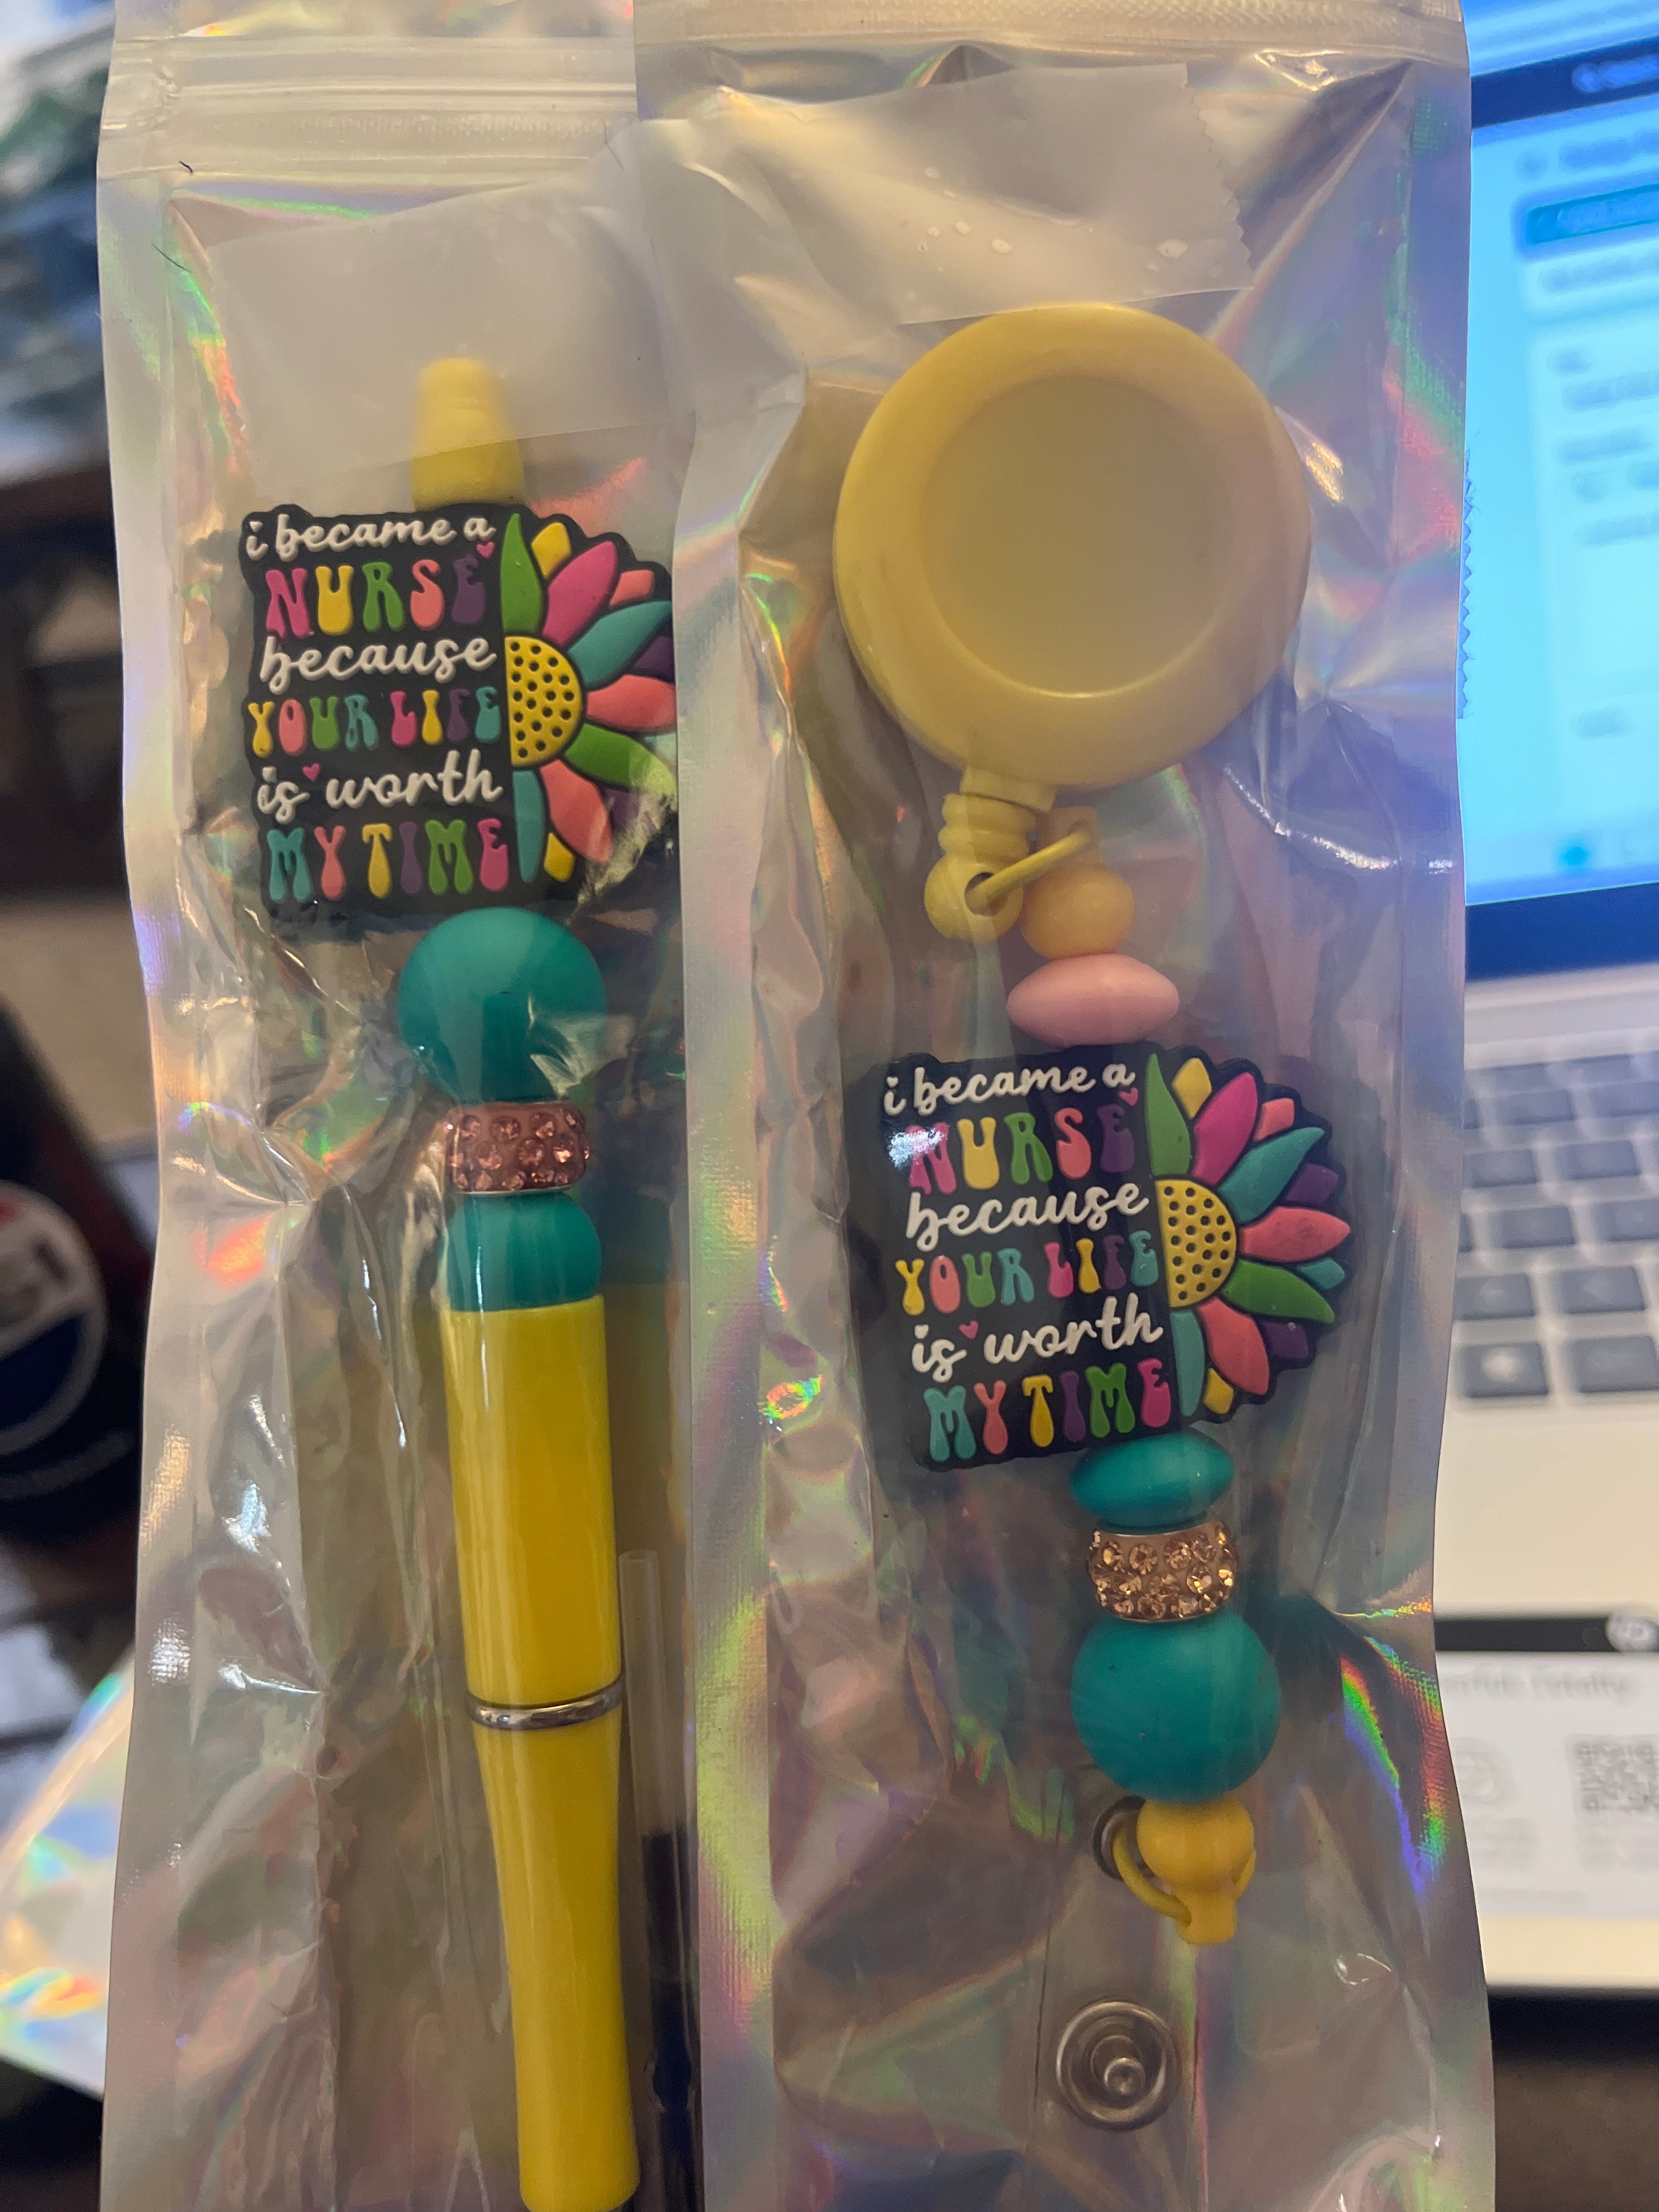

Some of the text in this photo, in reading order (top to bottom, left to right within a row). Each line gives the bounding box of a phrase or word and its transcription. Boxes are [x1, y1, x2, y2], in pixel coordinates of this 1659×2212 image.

[246, 514, 496, 562] i became a
[265, 555, 485, 639] NURSE
[259, 636, 497, 696] because
[248, 686, 502, 758] YOUR LIFE
[257, 749, 503, 823] is worth
[266, 818, 510, 903] MY TIME
[884, 1063, 1136, 1116] i became a
[905, 1104, 1134, 1194] NURSE
[905, 1181, 1149, 1252] because
[895, 1230, 1159, 1316] YOUR LIFE
[911, 1293, 1164, 1383] is worth
[923, 1358, 1171, 1462] MY TIME
